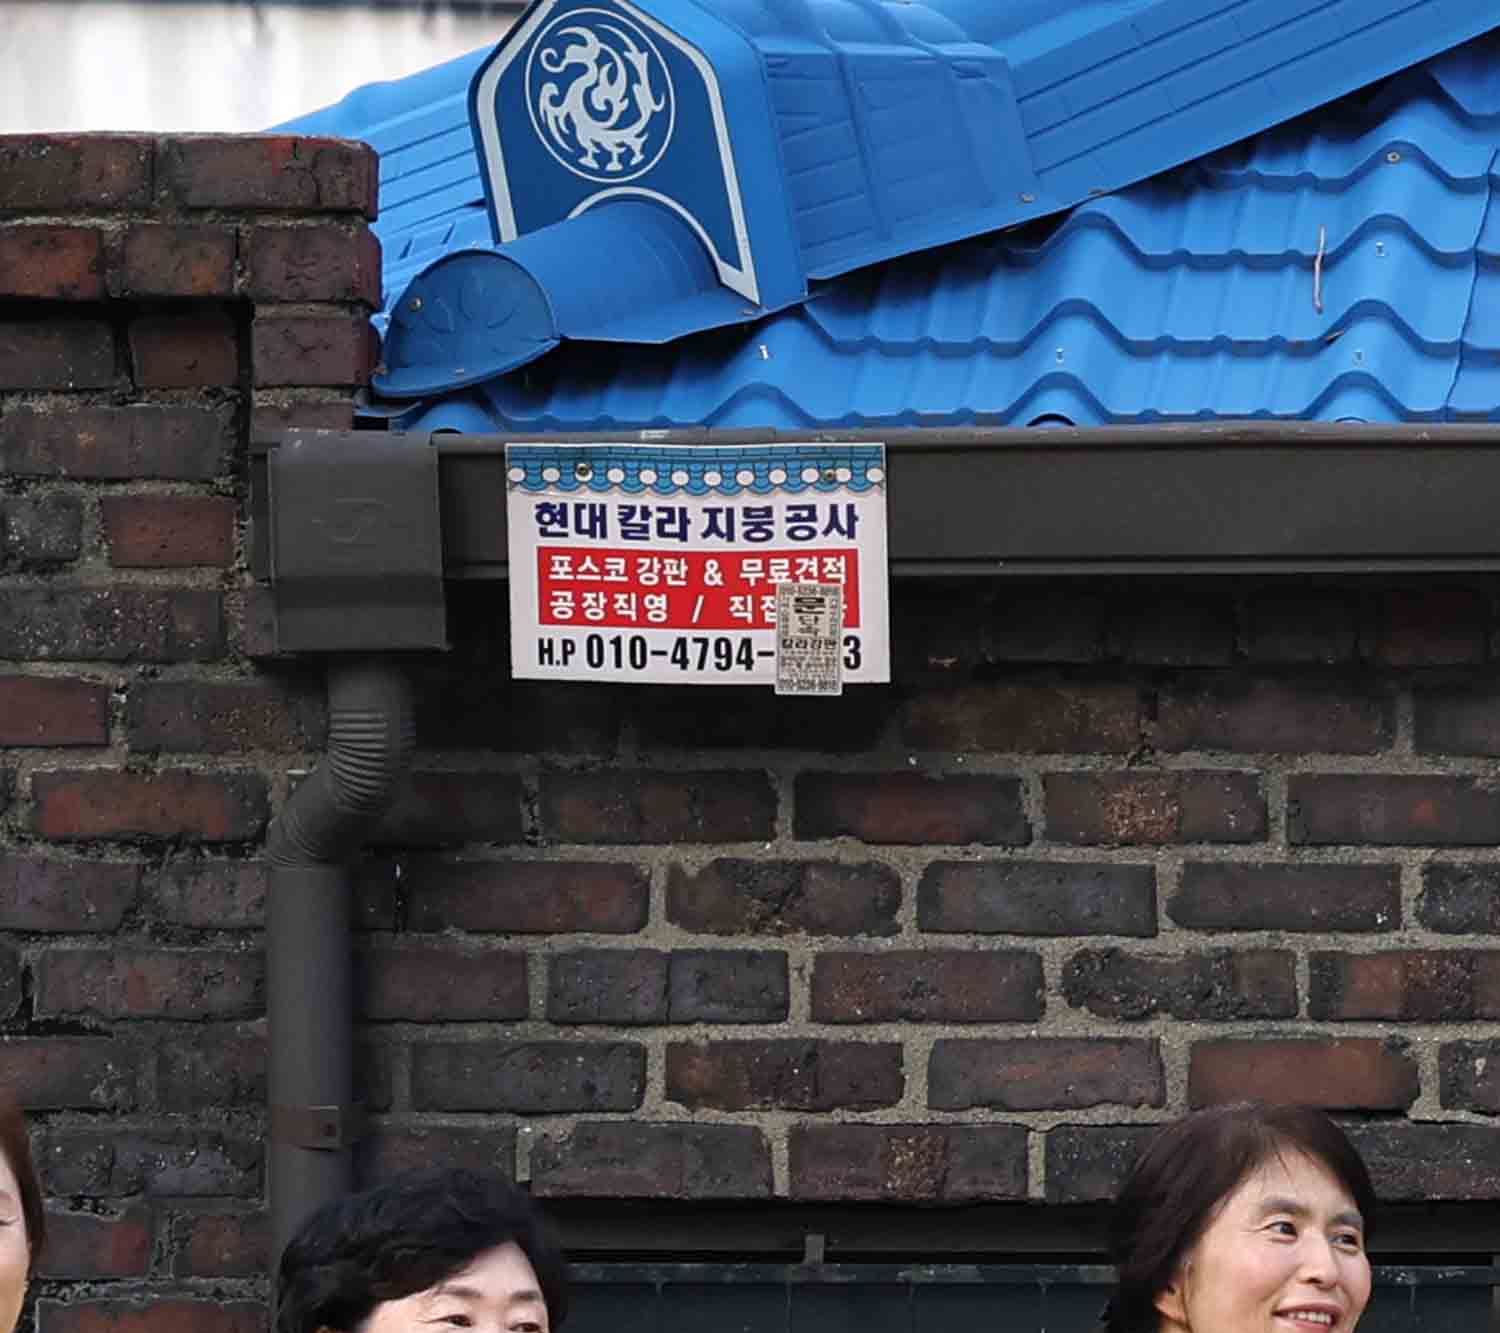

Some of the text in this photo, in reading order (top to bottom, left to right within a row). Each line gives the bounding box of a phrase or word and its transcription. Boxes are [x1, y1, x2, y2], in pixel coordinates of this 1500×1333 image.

[535, 502, 860, 542] 현대 칼라 지붕 공사
[549, 555, 847, 586] 포스코 강판 & 무료견적
[549, 590, 669, 622] 공장직영
[537, 637, 576, 667] H.P
[585, 633, 862, 672] 010-4794-3
